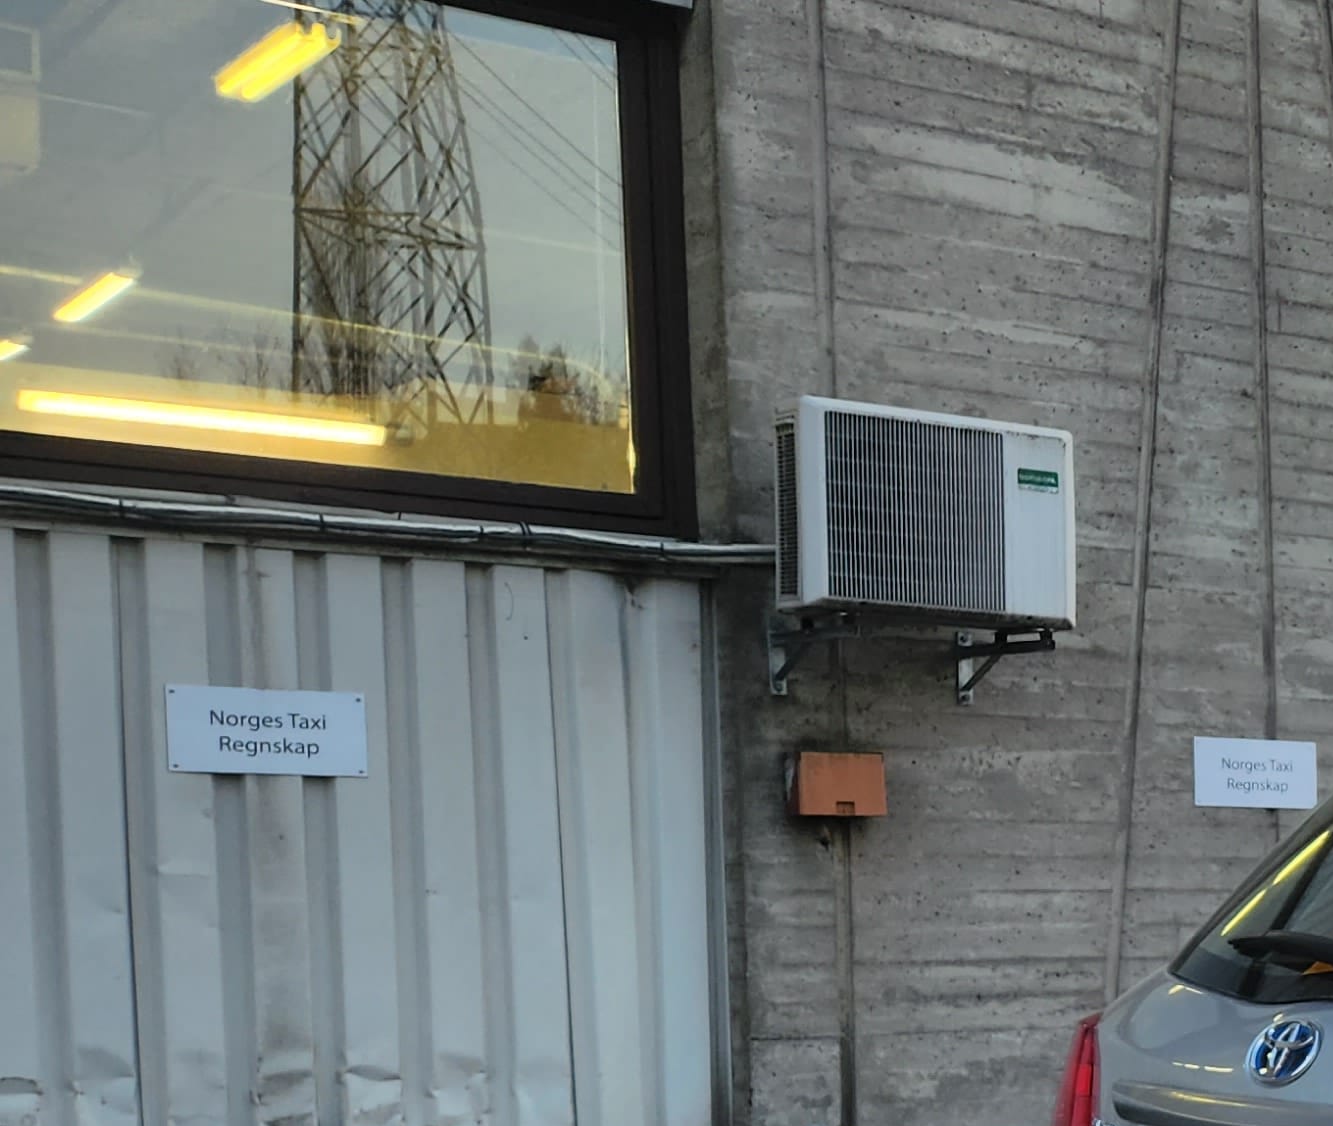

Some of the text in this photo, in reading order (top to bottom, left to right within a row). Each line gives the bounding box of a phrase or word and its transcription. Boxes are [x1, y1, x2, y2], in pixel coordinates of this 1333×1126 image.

[209, 709, 326, 731] Norges Taxi
[219, 735, 320, 758] Regnskap
[1221, 757, 1293, 774] Norges Taxi
[1227, 777, 1288, 794] Regnskap
